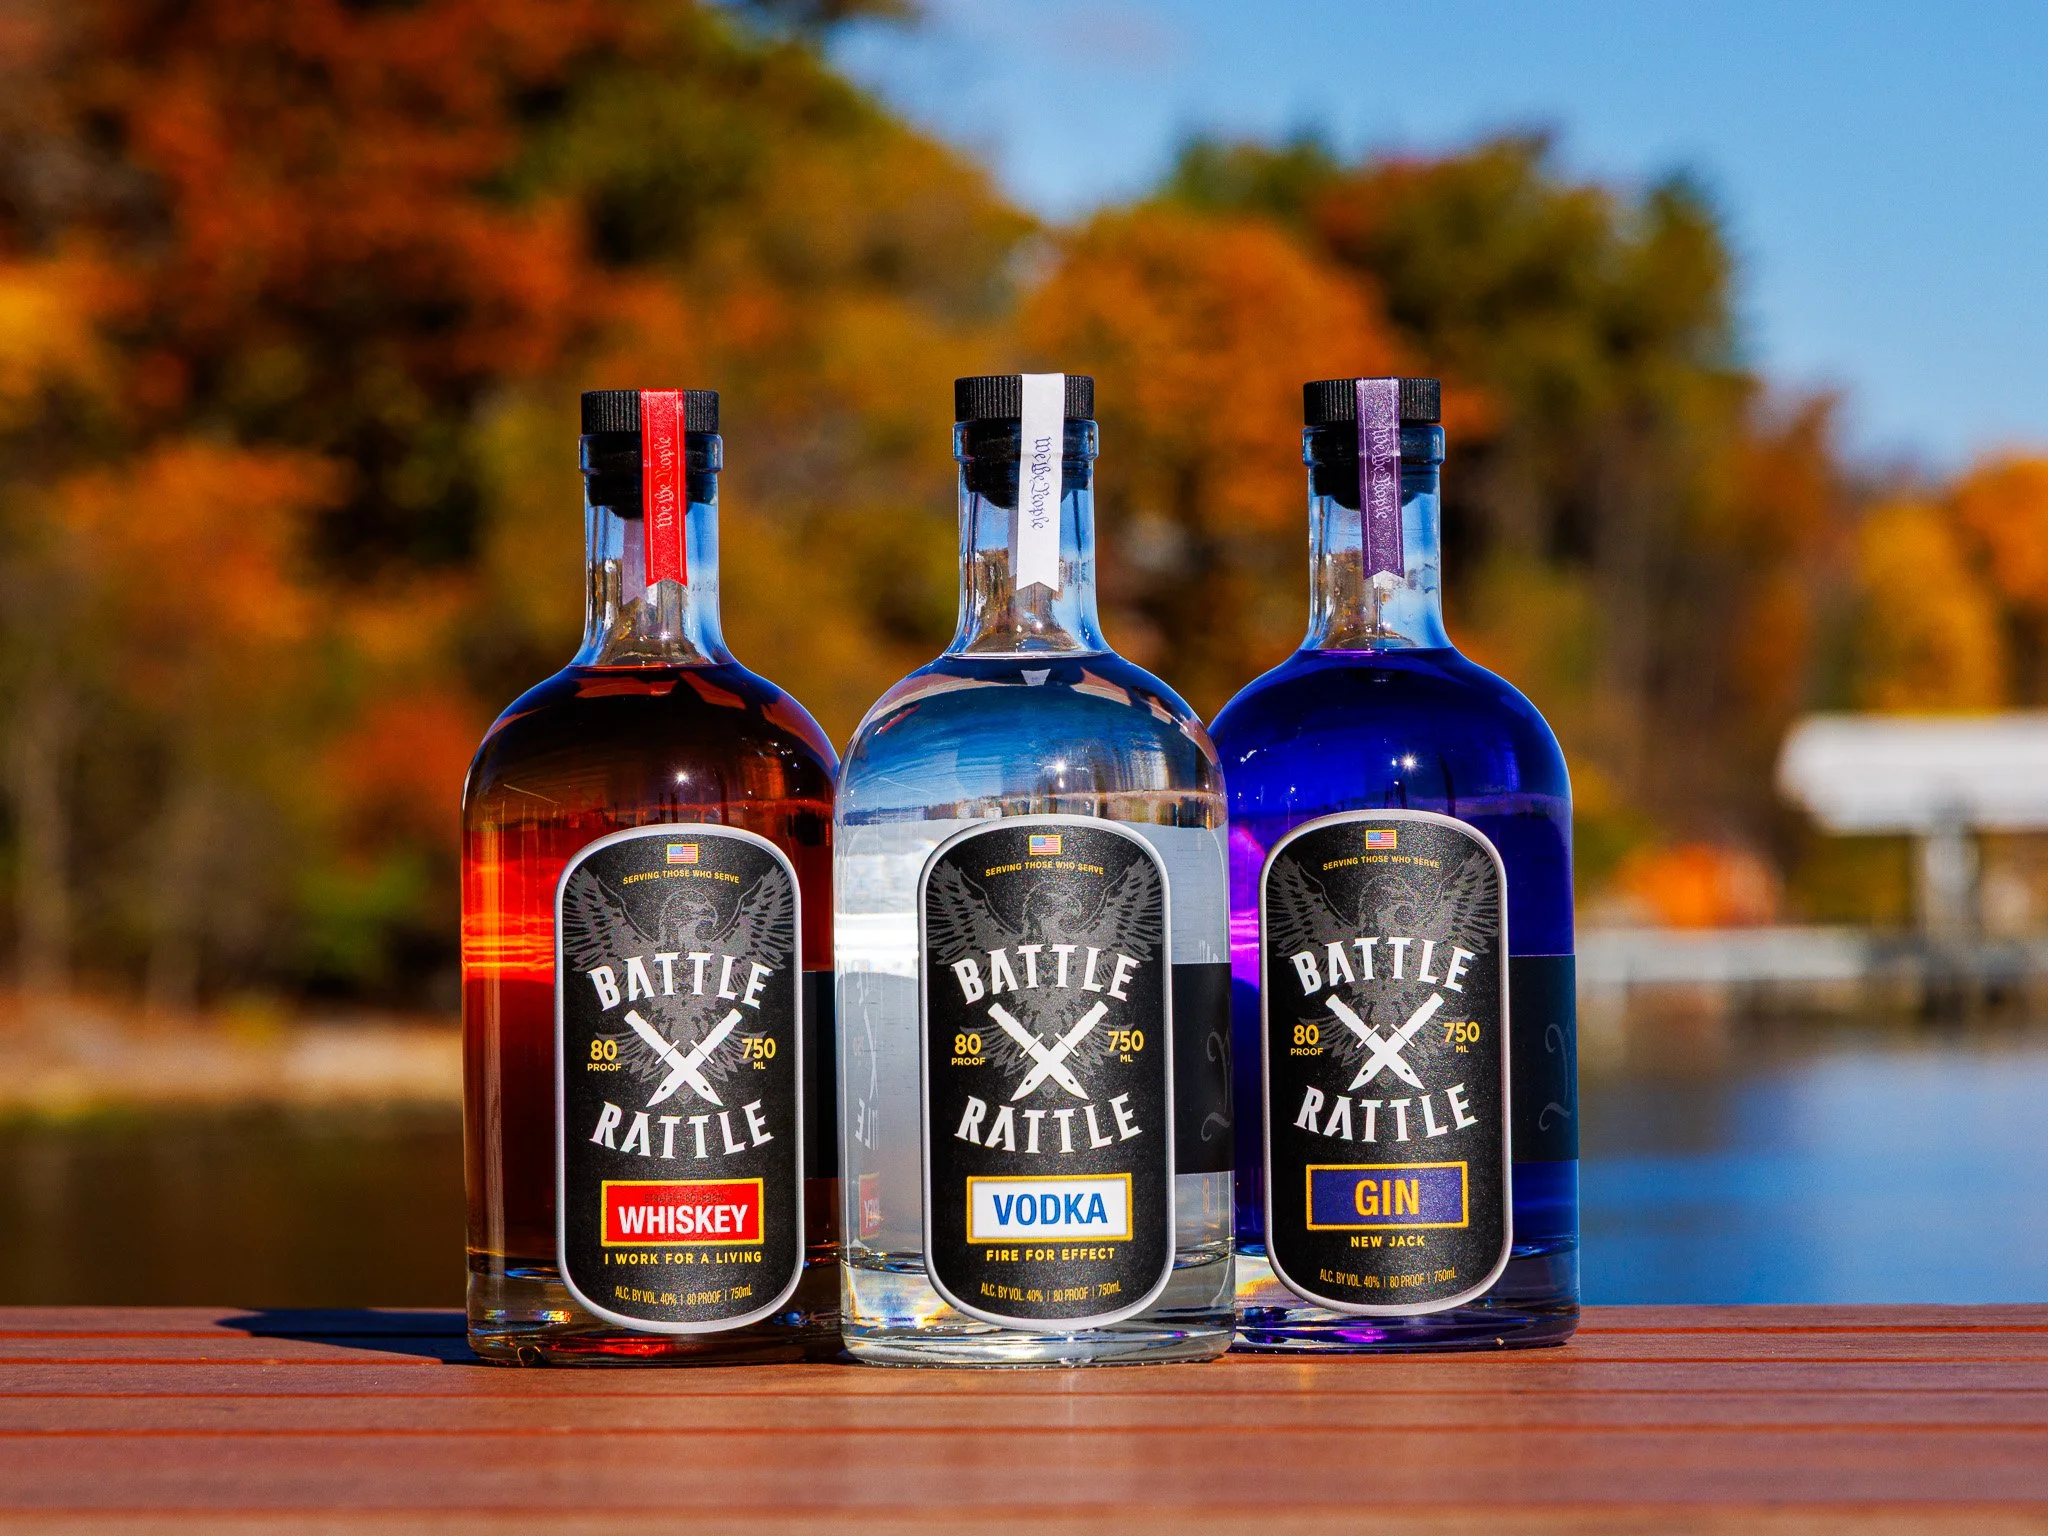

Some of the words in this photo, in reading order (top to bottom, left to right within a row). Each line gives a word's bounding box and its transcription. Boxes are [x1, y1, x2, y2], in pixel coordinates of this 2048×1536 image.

[1034, 437, 1052, 462] We
[1028, 480, 1050, 529] People
[985, 863, 1022, 877] SERVING
[1024, 861, 1053, 869] THOSE
[1055, 861, 1075, 870] WHO
[1078, 863, 1104, 875] SERVE
[1323, 857, 1358, 871] SERVING
[1361, 855, 1388, 863] THOSE
[1413, 857, 1440, 869] SERVE
[623, 871, 660, 885] SERVING
[662, 869, 690, 878] THOSE
[692, 869, 712, 878] WHO
[714, 871, 740, 884] SERVE
[950, 943, 1140, 1005] BATTLE
[1290, 936, 1476, 997] BATTLE
[587, 951, 774, 1012] BATTLE
[1108, 1030, 1144, 1052] 750
[1293, 1024, 1320, 1045] 80
[1443, 1021, 1480, 1042] 750
[590, 1039, 618, 1061] 80
[741, 1038, 776, 1059] 750
[954, 1033, 982, 1054] 80
[1290, 1047, 1323, 1056] PROOF
[1456, 1045, 1468, 1053] ML
[587, 1063, 622, 1072] PROOF
[753, 1062, 766, 1070] ML
[951, 1057, 986, 1066] PROOF
[1120, 1054, 1133, 1062] ML
[1292, 1082, 1478, 1142] RATTLE
[588, 1099, 774, 1159] RATTLE
[953, 1092, 1143, 1154] RATTLE
[1354, 1179, 1420, 1216] GIN
[618, 1204, 748, 1234] WHISKEY
[993, 1192, 1108, 1225] VODKA
[1351, 1236, 1383, 1248] NEW
[1389, 1235, 1425, 1247] JACK
[604, 1253, 609, 1265] I
[615, 1253, 659, 1265] WORK
[665, 1253, 694, 1264] FOR
[700, 1253, 710, 1264] A
[716, 1251, 762, 1263] LIVING
[986, 1249, 1019, 1261] FIRE
[1025, 1249, 1055, 1261] FOR
[1062, 1248, 1115, 1261] EFFECT
[1320, 1268, 1335, 1283] ALC.
[1336, 1272, 1346, 1284] BY
[1346, 1273, 1361, 1287] VOL.
[1363, 1276, 1380, 1288] 40%
[1389, 1275, 1399, 1288] 80
[1400, 1273, 1424, 1286] PROOF
[615, 1286, 631, 1300] ALC.
[632, 1289, 642, 1301] BY
[643, 1290, 659, 1304] VOL.
[660, 1293, 677, 1306] 40%
[687, 1293, 696, 1305] 80
[697, 1290, 721, 1304] PROOF
[980, 1282, 996, 1298] ALC.
[998, 1285, 1008, 1299] BY
[1008, 1287, 1024, 1301] VOL.
[1026, 1290, 1043, 1302] 40%
[1053, 1290, 1062, 1302] 80
[1064, 1286, 1088, 1301] PROOF
